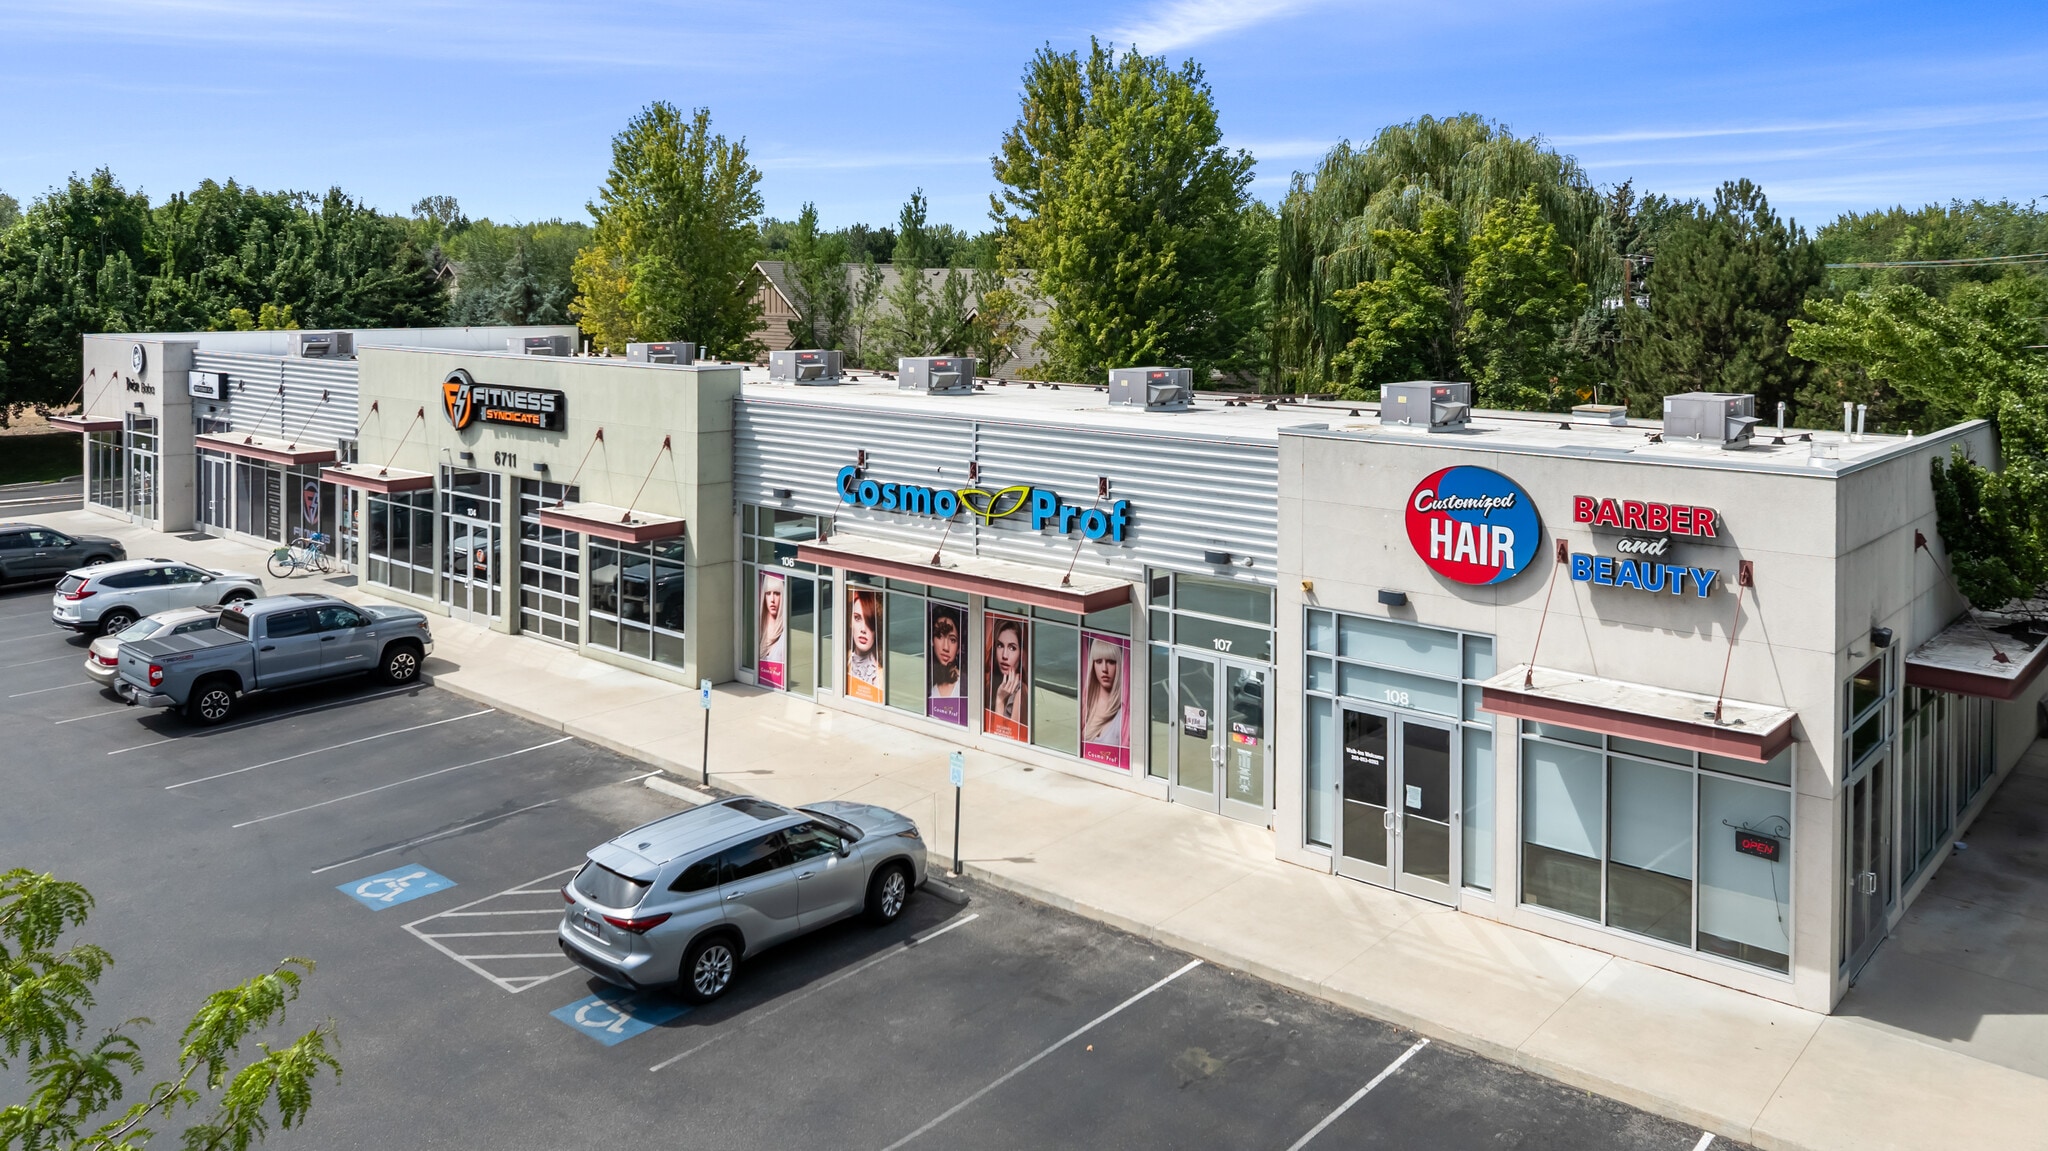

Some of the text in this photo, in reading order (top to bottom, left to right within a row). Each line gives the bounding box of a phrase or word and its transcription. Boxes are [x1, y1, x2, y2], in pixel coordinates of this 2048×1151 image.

[472, 387, 555, 412] FITNESS
[486, 408, 540, 425] SYNDICATE
[494, 451, 517, 468] 6711
[836, 465, 1130, 542] Cosmo Prof
[1414, 489, 1516, 517] Customized
[467, 508, 477, 517] 104
[1573, 495, 1719, 538] BARBER
[1429, 517, 1516, 570] HAIR
[1617, 536, 1669, 556] and
[781, 556, 795, 567] 106
[1571, 552, 1719, 598] BEAUTY
[1213, 638, 1233, 652] 107
[1383, 689, 1409, 705] 108
[1741, 839, 1774, 854] OPEN
